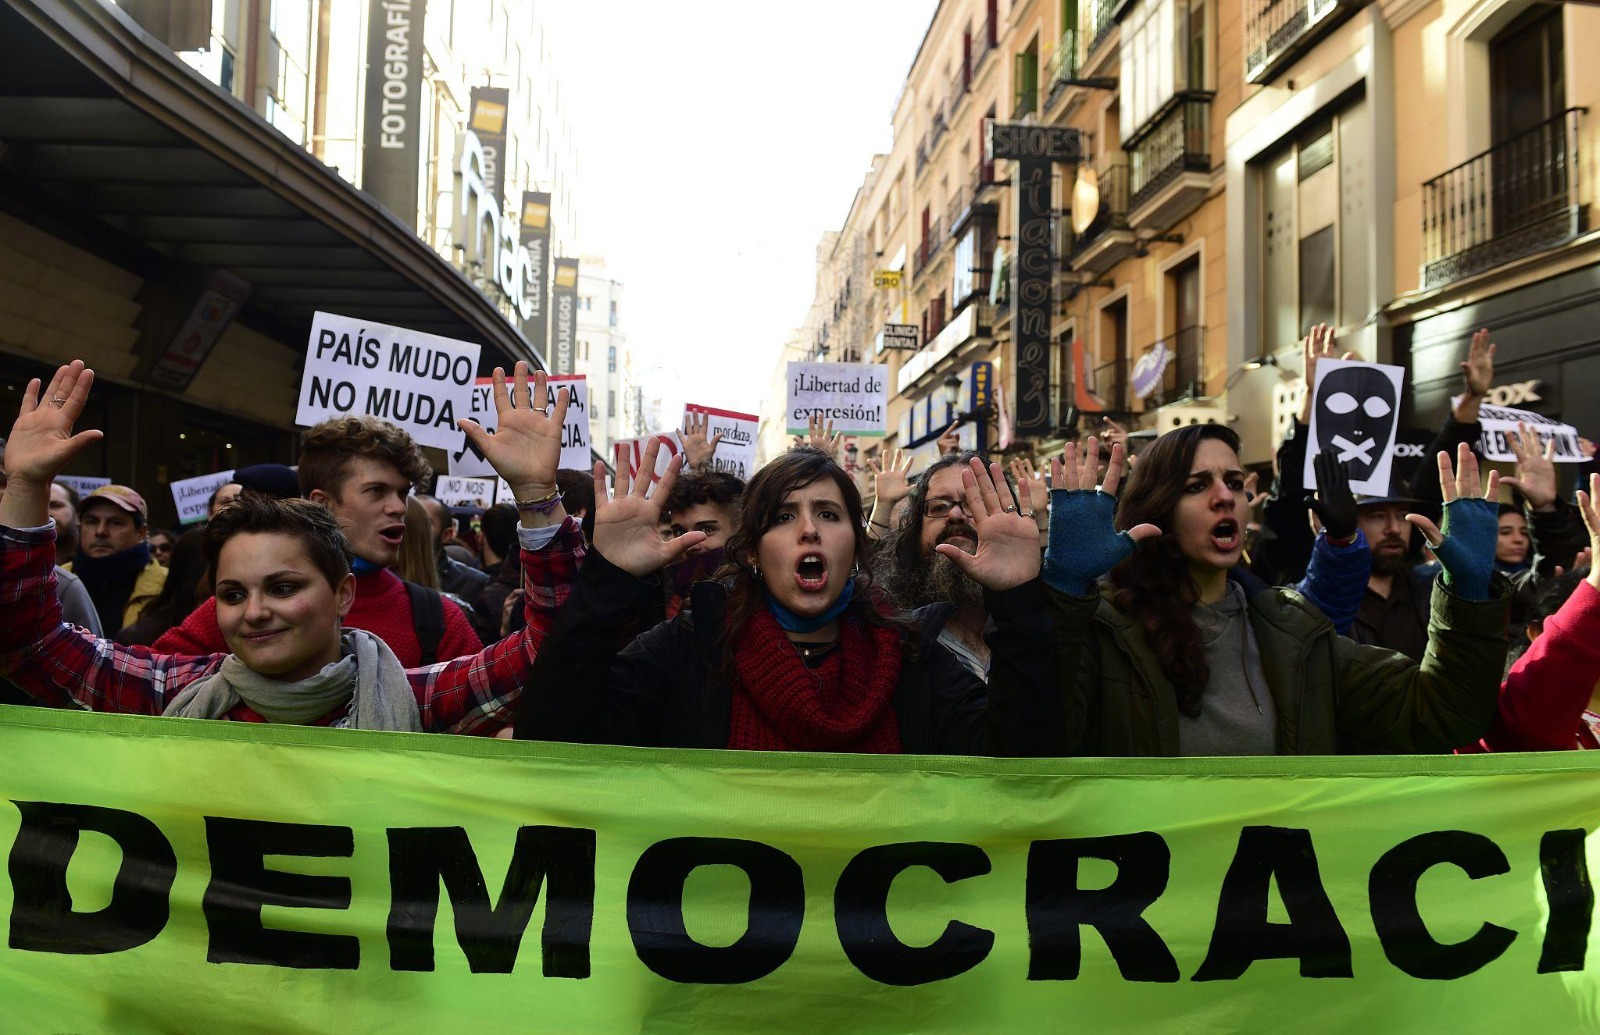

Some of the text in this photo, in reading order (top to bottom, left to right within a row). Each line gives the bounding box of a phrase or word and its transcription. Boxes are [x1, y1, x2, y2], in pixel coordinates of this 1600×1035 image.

[381, 0, 412, 149] FOTOGRAFÍ
[993, 126, 1078, 157] SHOES
[316, 328, 472, 385] PAÍS MUDO
[309, 376, 356, 411] NO
[469, 387, 491, 412] EY
[794, 373, 881, 396] ¡Libertad de
[793, 404, 880, 423] expresión!
[8, 800, 1594, 986] DEMOCRACI
